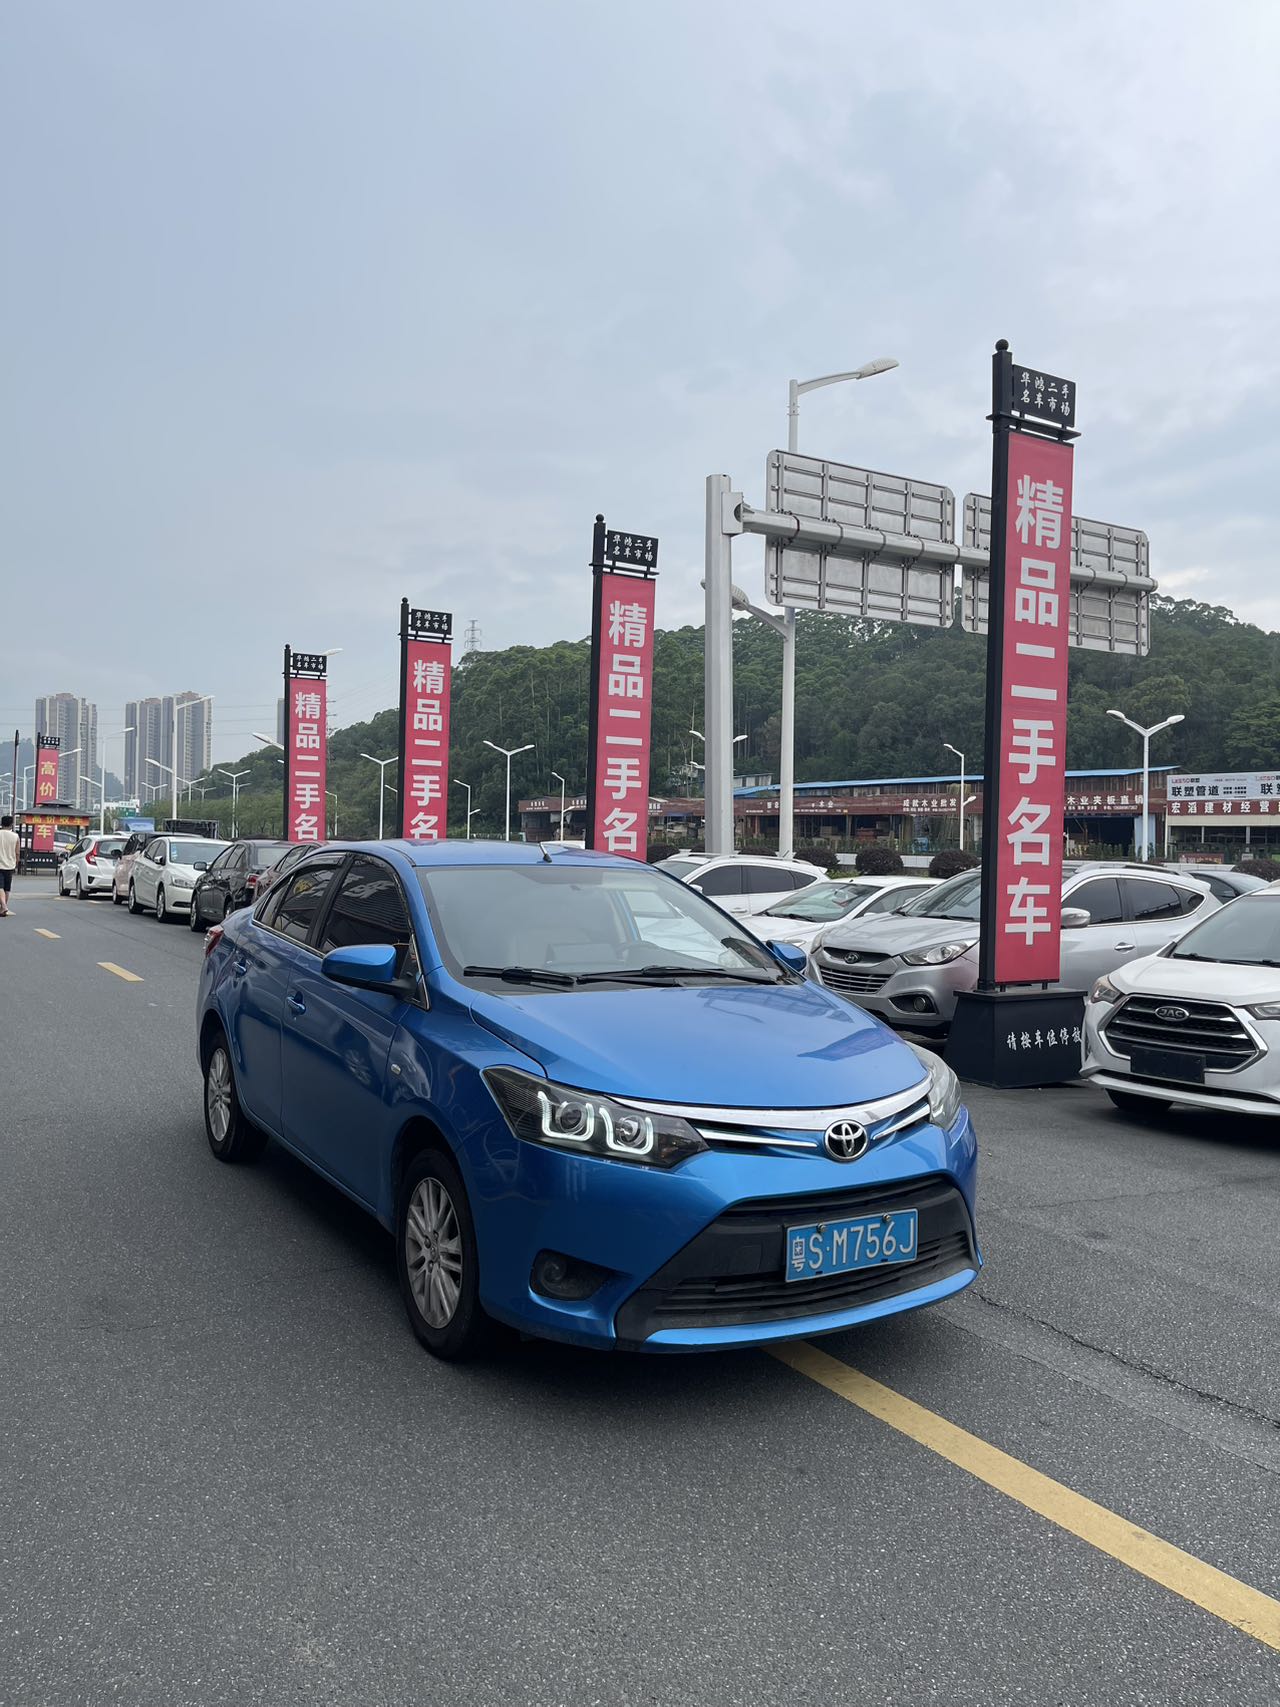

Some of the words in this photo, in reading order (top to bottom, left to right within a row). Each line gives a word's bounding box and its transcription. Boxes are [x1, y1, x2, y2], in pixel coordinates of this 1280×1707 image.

[1021, 389, 1071, 416] 名车市场
[612, 546, 654, 562] 名车市场
[1005, 475, 1064, 945] 精品二手名车
[603, 600, 647, 852] 精品二手名
[1171, 785, 1219, 796] 联塑管道
[1171, 801, 1280, 813] 宏滔建材经营
[1159, 1008, 1184, 1017] JAC
[1007, 1027, 1082, 1050] 请按车位停放
